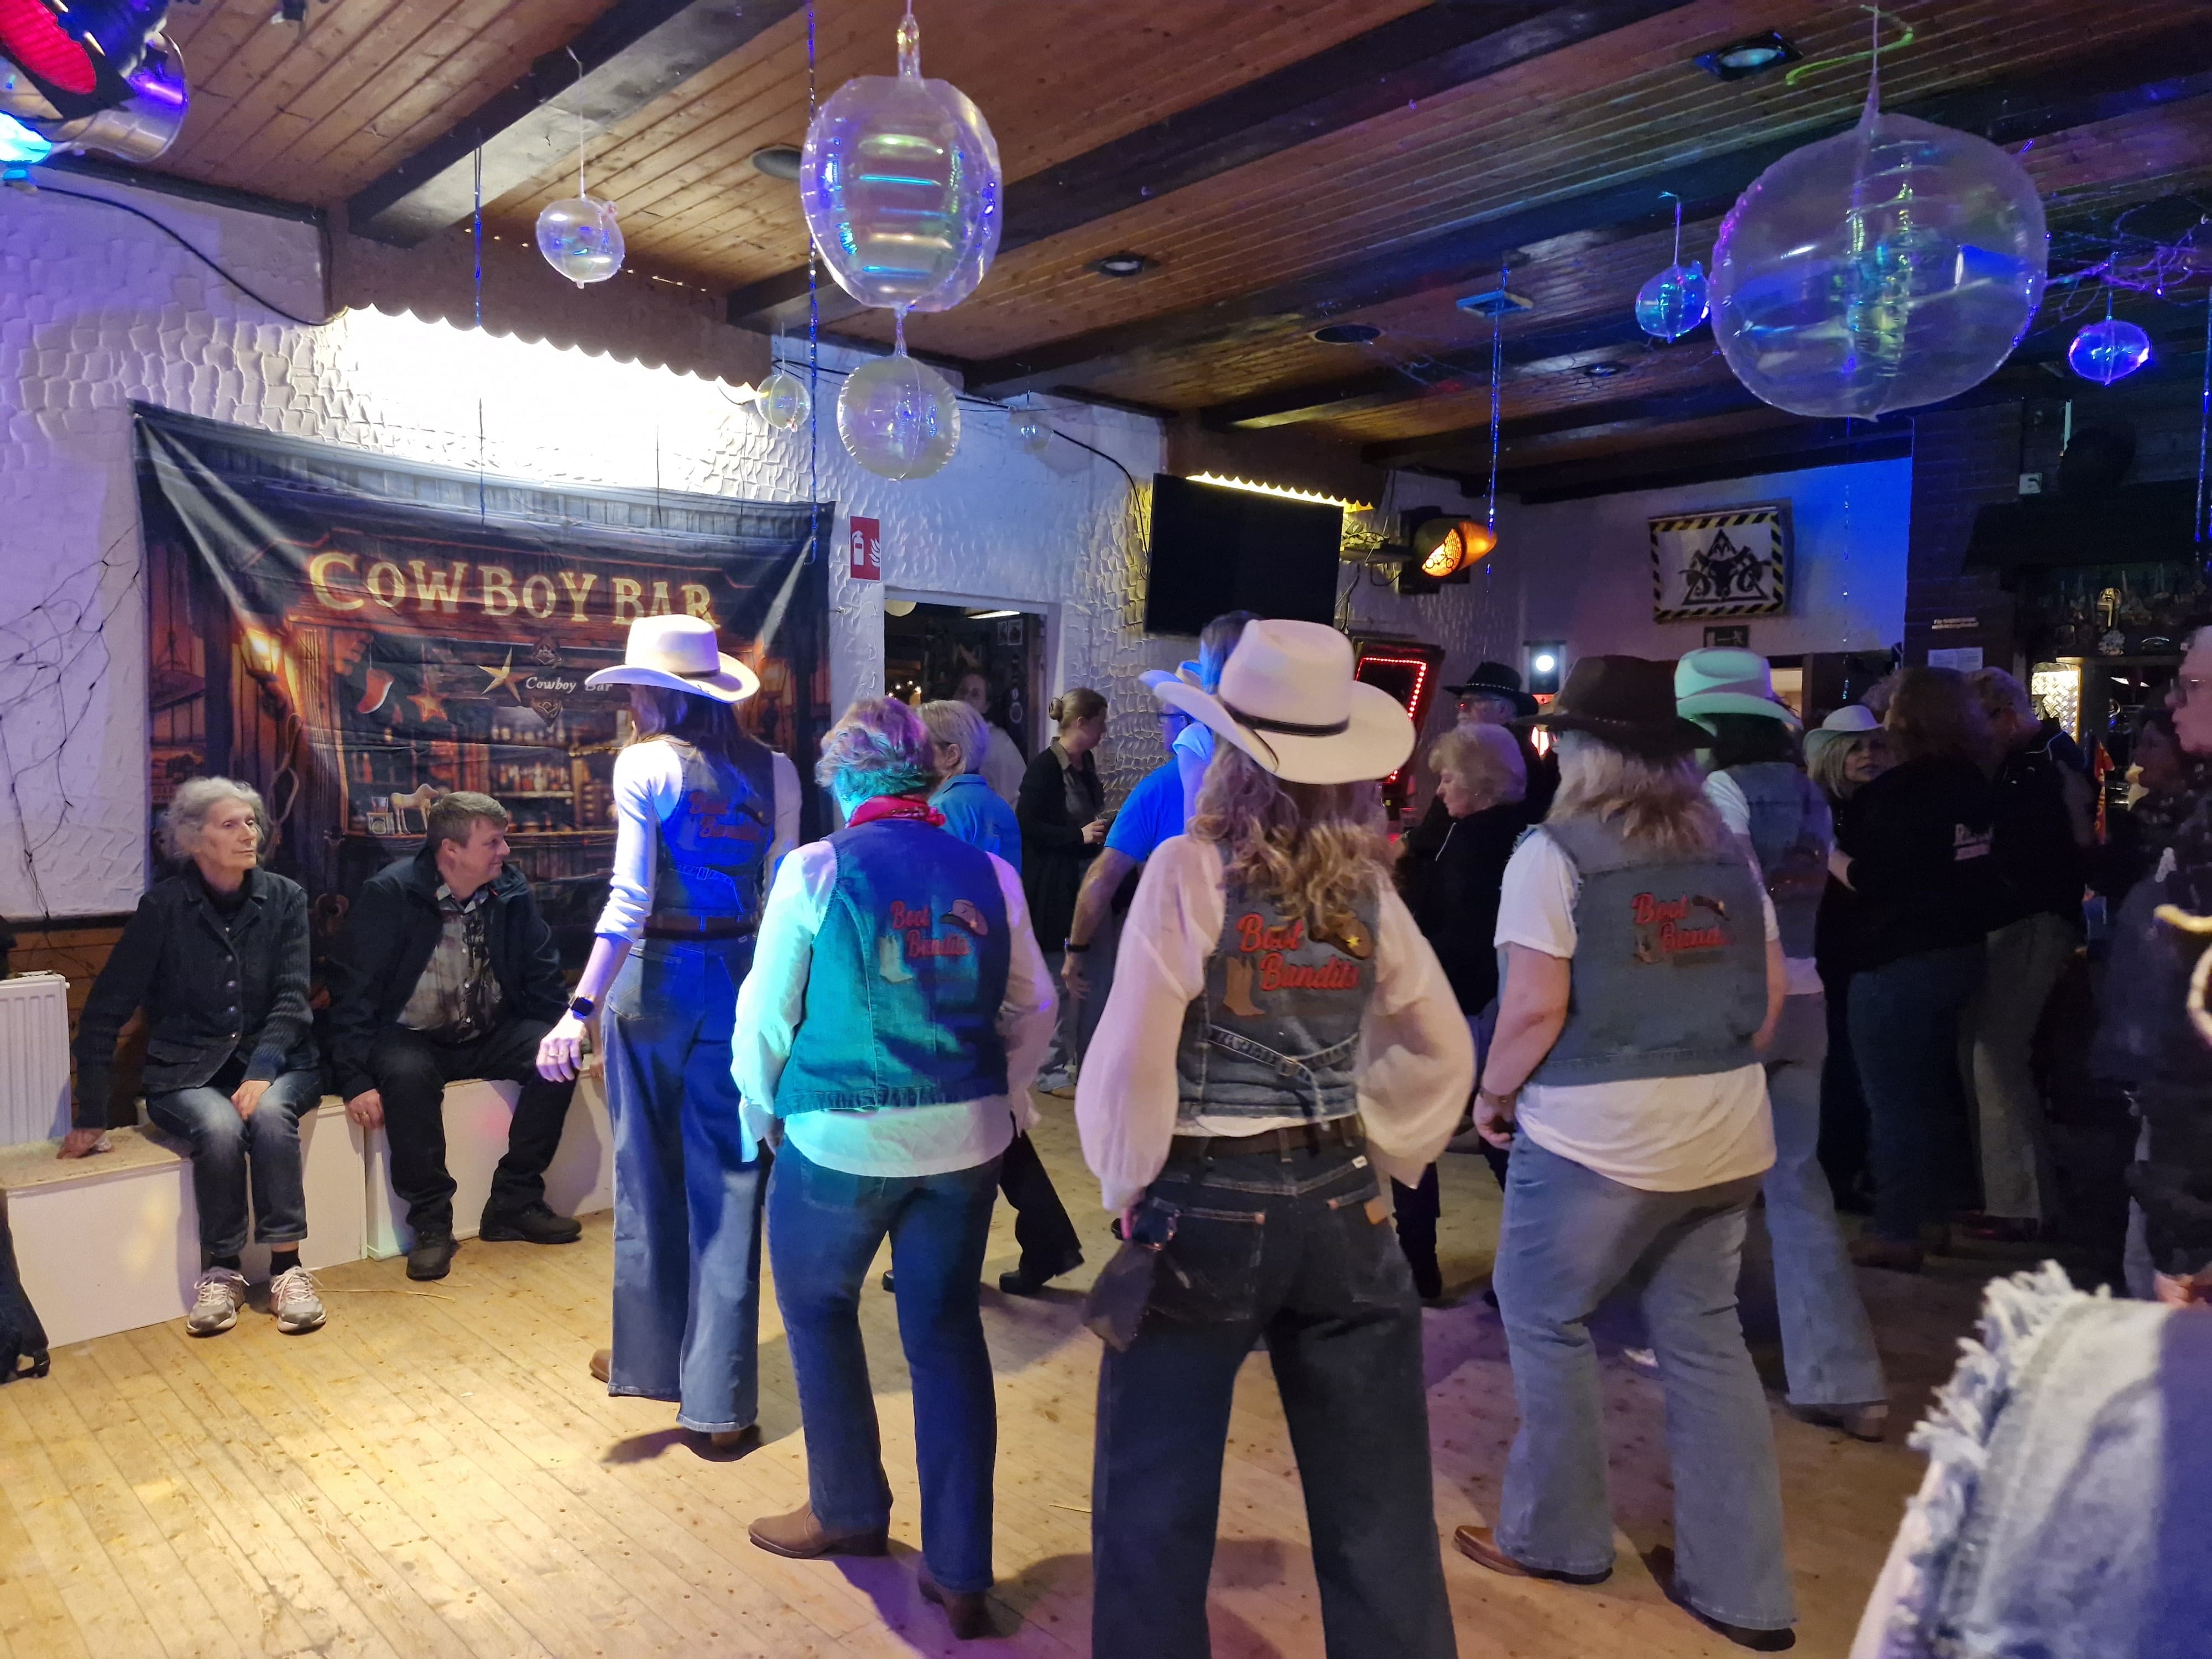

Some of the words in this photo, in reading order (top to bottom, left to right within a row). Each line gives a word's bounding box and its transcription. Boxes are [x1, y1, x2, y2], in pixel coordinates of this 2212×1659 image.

[310, 552, 597, 622] COWBOY
[612, 577, 721, 628] BAR
[525, 676, 577, 694] Cowboy
